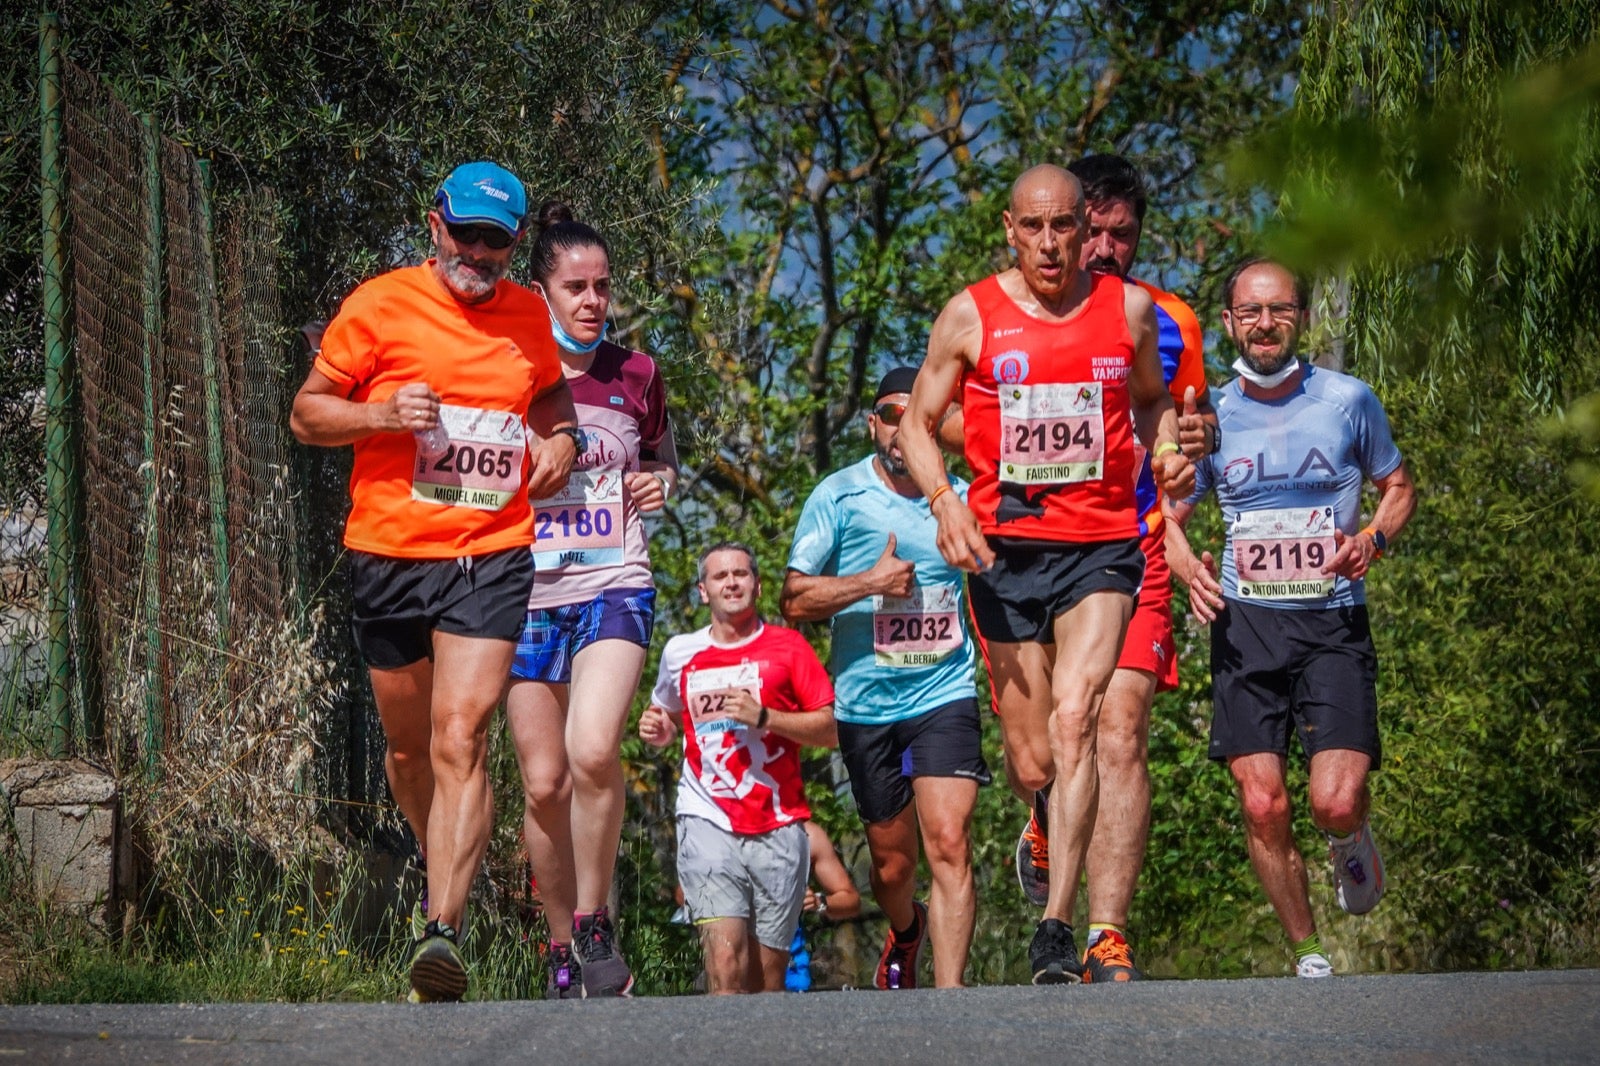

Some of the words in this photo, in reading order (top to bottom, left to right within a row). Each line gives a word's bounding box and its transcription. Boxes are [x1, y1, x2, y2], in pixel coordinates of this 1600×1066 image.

[1091, 356, 1126, 366] RUNNING
[1014, 420, 1093, 453] 2194
[433, 443, 514, 479] 2065
[1026, 466, 1070, 481] FAUSTINO
[434, 487, 469, 504] MIGUEL
[472, 491, 499, 506] ANGEL
[1265, 480, 1338, 493] VALIENTES
[535, 508, 612, 540] 2180
[1249, 541, 1325, 571] 2119
[1252, 583, 1287, 597] ANTONIO
[1289, 583, 1322, 595] MARINO
[889, 616, 952, 642] 2032
[903, 653, 938, 665] ALBERTO
[700, 689, 752, 715] 22
